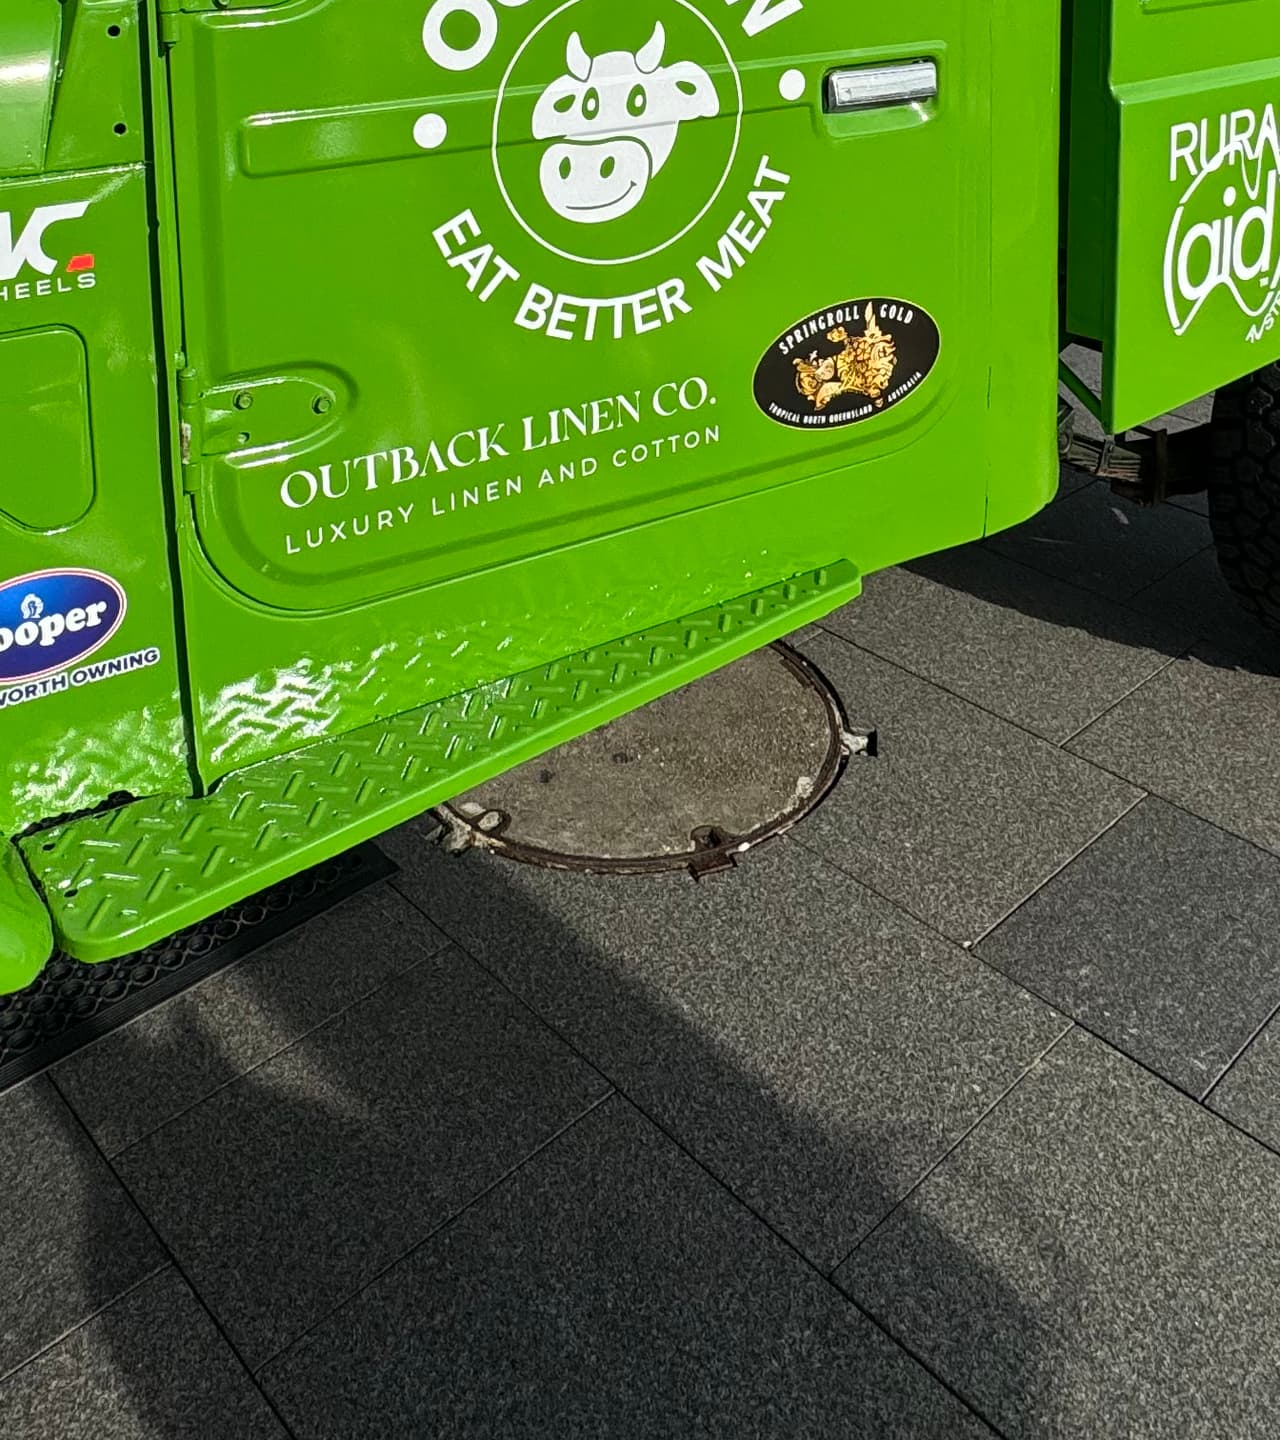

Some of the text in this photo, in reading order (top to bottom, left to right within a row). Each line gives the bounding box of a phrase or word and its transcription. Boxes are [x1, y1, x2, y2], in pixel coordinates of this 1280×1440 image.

[431, 154, 792, 341] EAT BETTER MEAT
[778, 303, 914, 356] SPRINGROLL GOLD
[768, 402, 873, 425] TROPICAL NORTH QUEENSLAND
[887, 371, 922, 403] AUSTRALIA
[280, 376, 717, 509] OUTBACK LINEN CO.
[285, 425, 720, 555] LUXURY LINEN AND COTTON
[73, 649, 159, 684] OWNING
